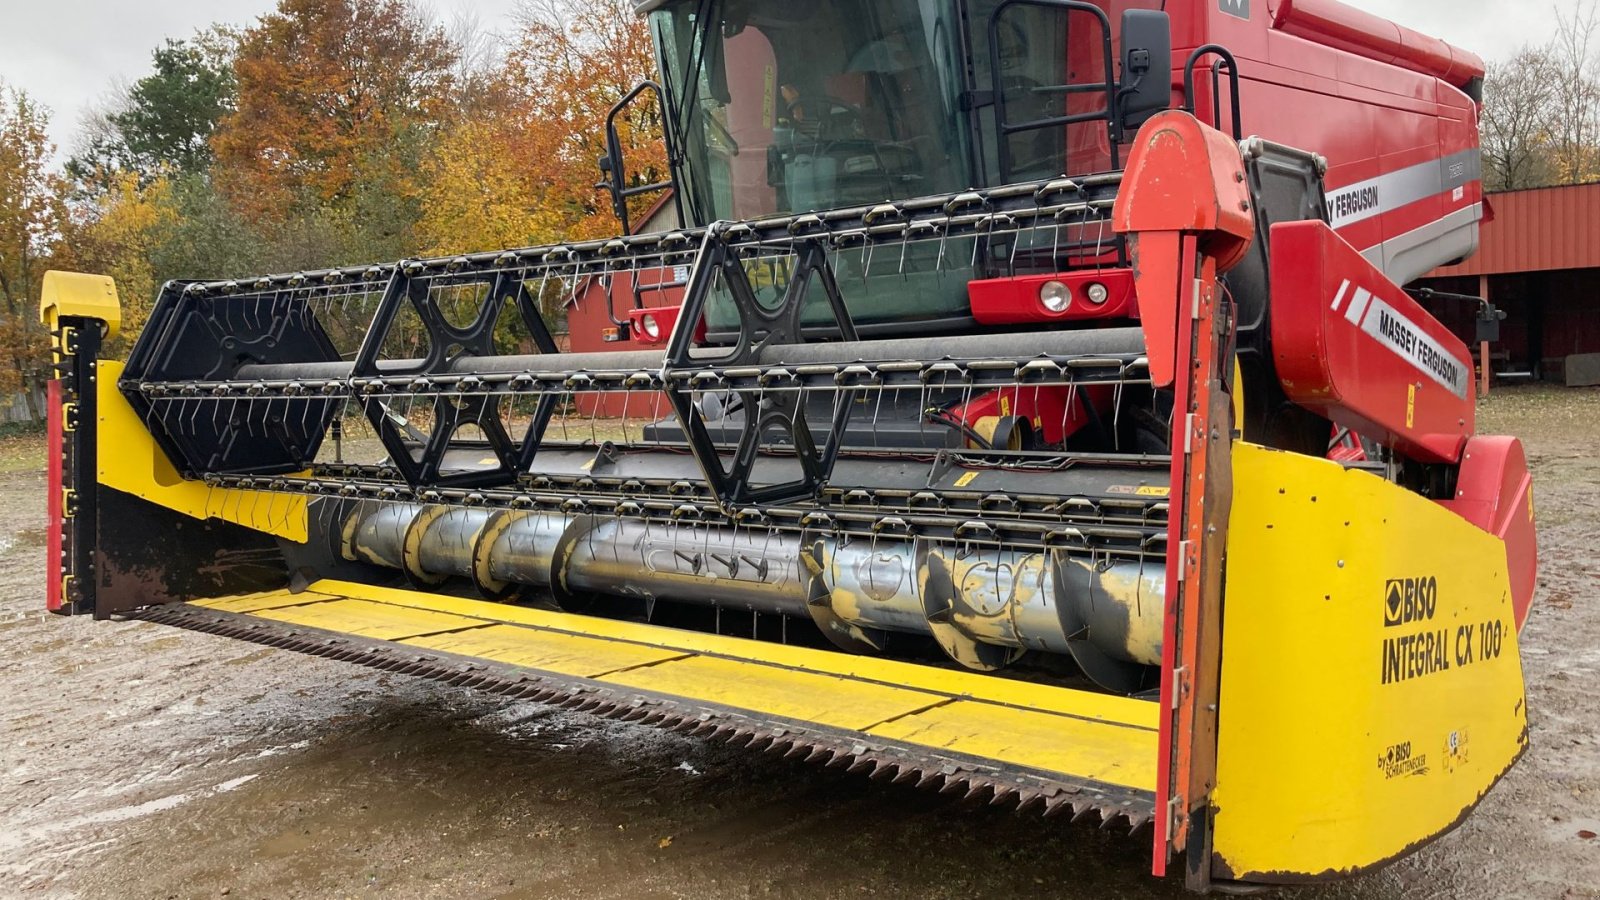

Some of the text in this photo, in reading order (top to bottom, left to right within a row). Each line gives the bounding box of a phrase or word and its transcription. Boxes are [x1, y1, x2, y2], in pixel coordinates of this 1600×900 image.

[1336, 185, 1378, 218] FERGUSON
[1380, 310, 1458, 387] MASSEY FERGUSON
[1403, 576, 1437, 623] BISO
[1381, 619, 1501, 685] INTEGRAL CX 100
[1377, 741, 1411, 771] by BISO
